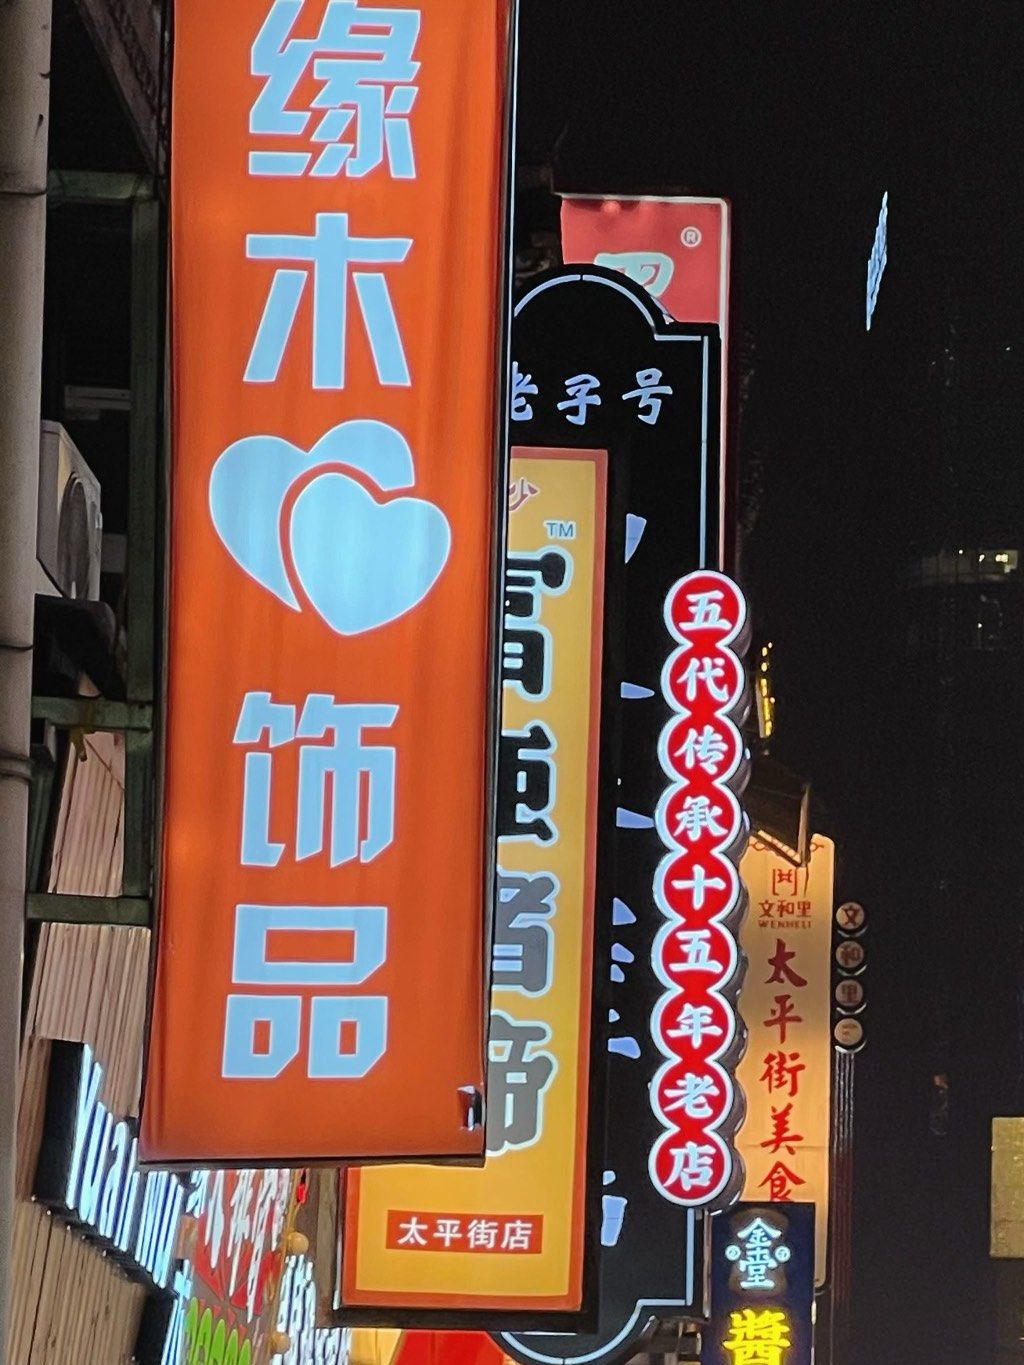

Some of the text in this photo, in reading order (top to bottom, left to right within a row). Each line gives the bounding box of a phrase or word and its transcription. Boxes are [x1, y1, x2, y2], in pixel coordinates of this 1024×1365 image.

[667, 591, 732, 1188] 五代传承十五年老店
[758, 901, 811, 918] 文和里
[758, 938, 808, 1201] 太平街美食
[398, 1217, 533, 1250] 太平街店
